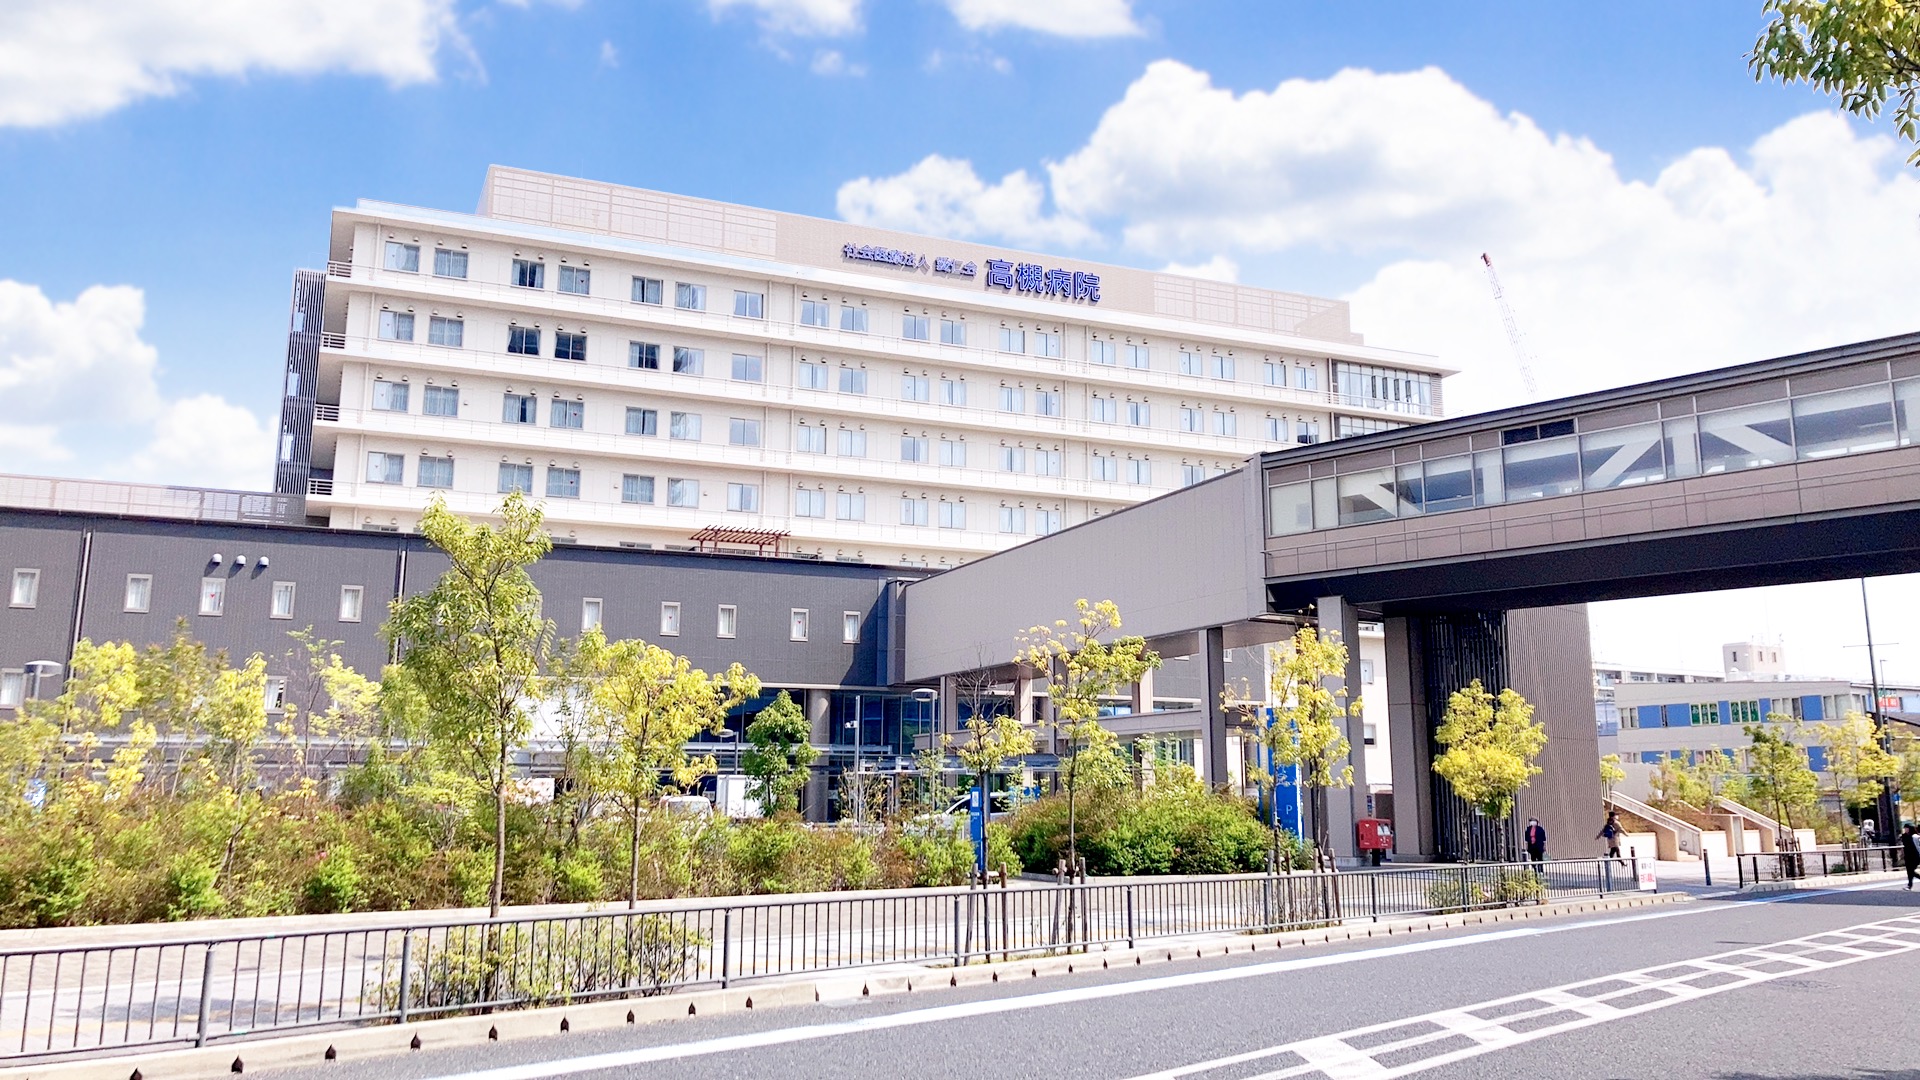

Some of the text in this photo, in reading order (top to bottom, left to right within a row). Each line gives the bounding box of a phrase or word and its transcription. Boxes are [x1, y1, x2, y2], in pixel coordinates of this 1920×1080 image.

[844, 242, 930, 269] 社会医療法人
[986, 258, 1101, 302] 高槻病院
[1286, 804, 1292, 814] P
